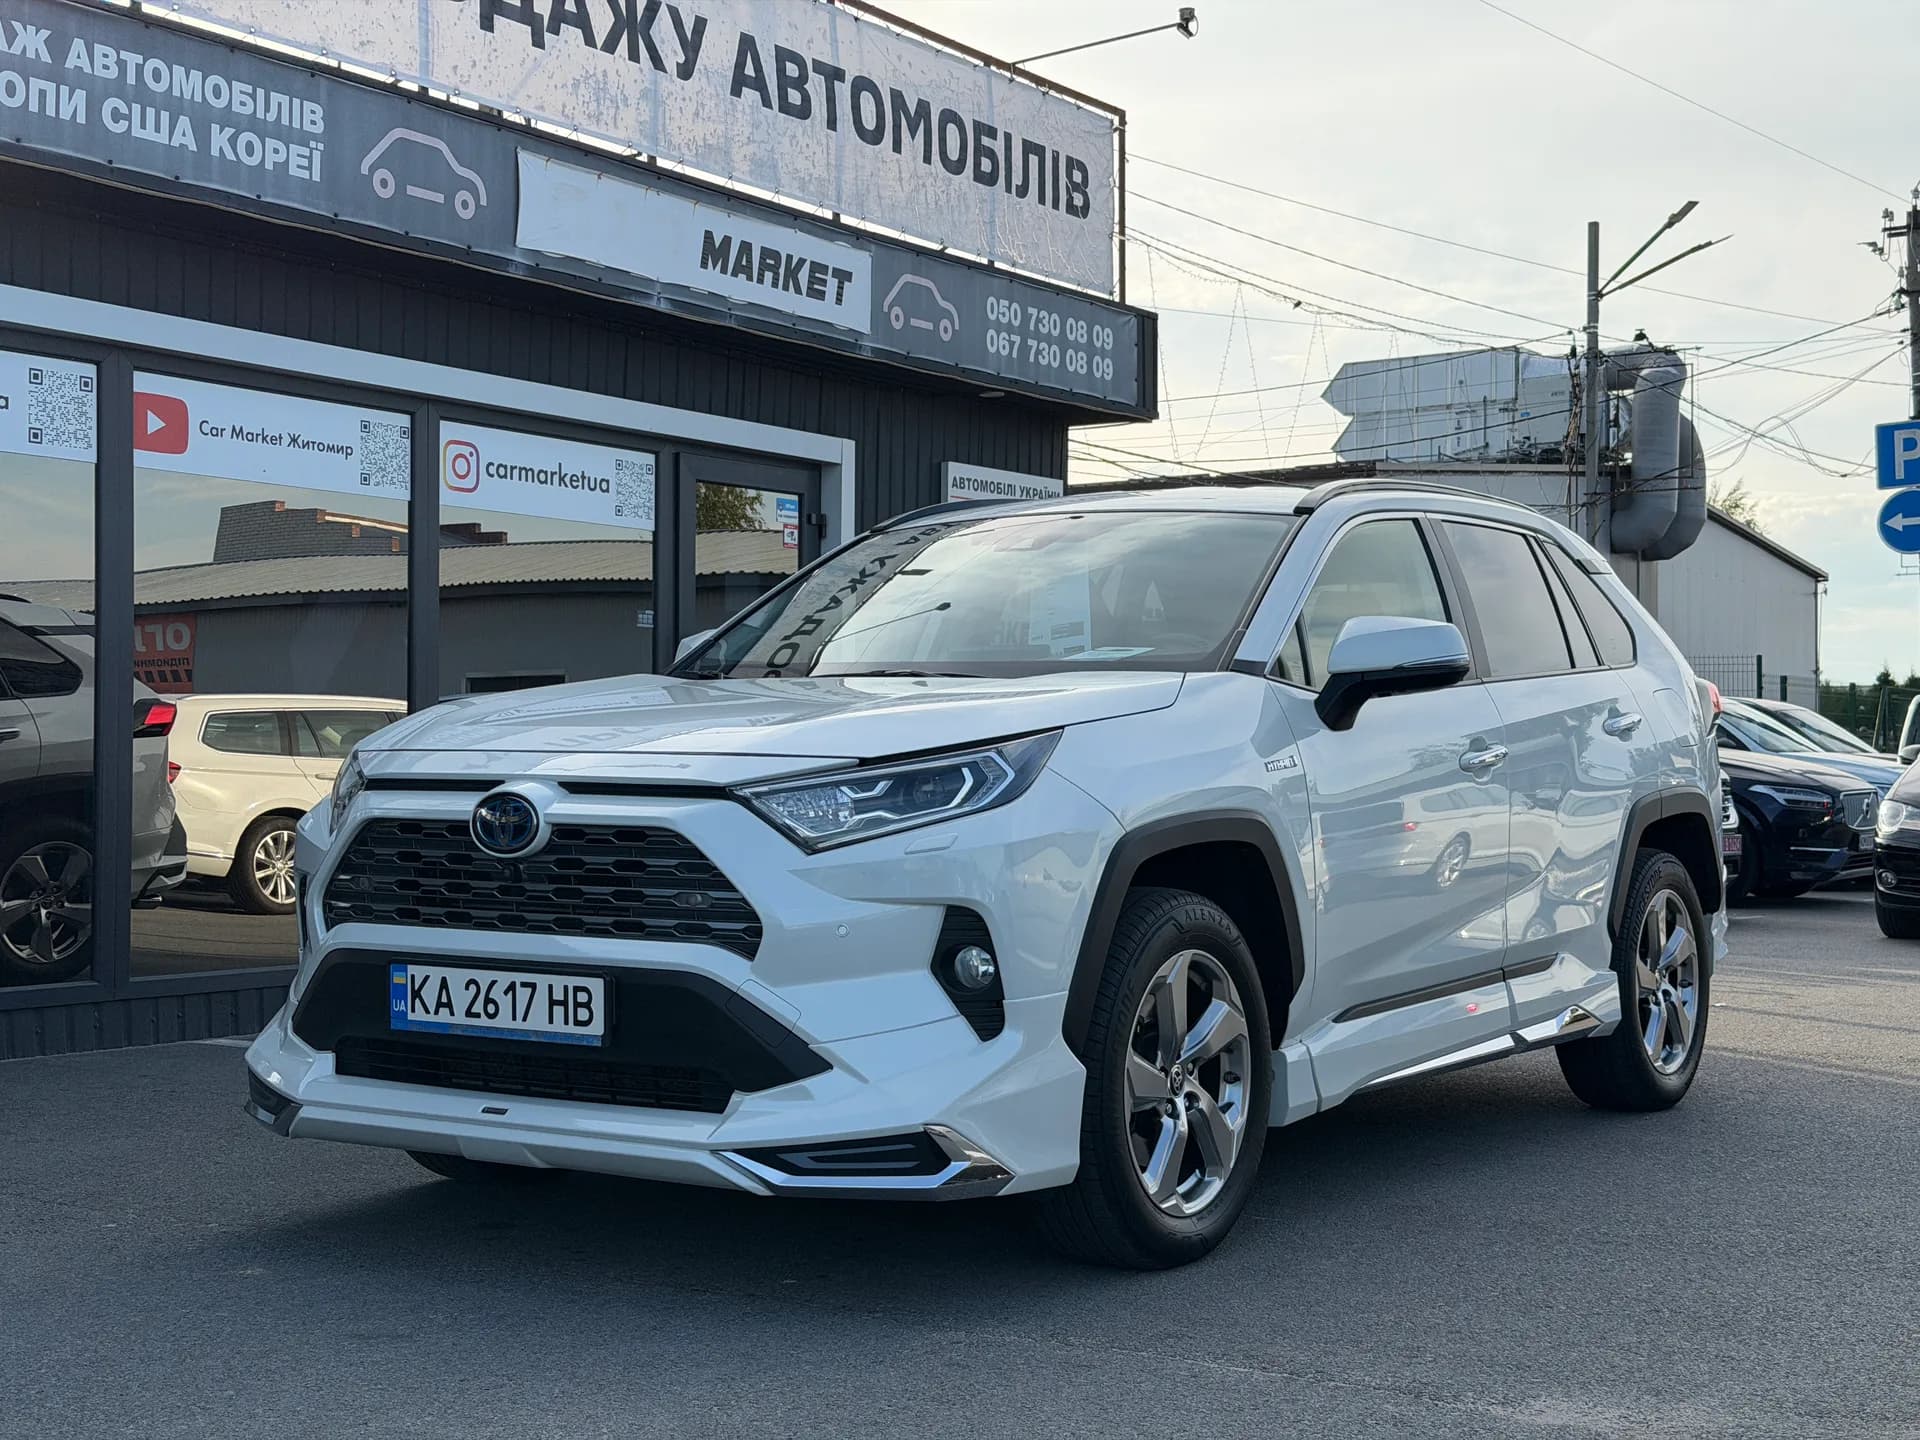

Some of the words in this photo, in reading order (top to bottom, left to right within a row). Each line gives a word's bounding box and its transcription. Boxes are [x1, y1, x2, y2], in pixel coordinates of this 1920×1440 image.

[64, 37, 325, 134] АВТОМОБІЛІВ
[451, 0, 708, 81] ДАЖУ
[730, 31, 1091, 220] АВТОМОБІЛІВ
[101, 97, 197, 152] США
[210, 122, 325, 182] КОРЕЇ
[699, 229, 854, 306] MARKET
[986, 296, 1021, 327] 050
[1027, 306, 1060, 337] 730
[1066, 317, 1087, 343] 08
[1093, 325, 1113, 350] 09
[986, 329, 1021, 358] 067
[1027, 338, 1060, 368] 730
[1066, 349, 1087, 375] 08
[1093, 355, 1113, 380] 09
[199, 420, 226, 438] Car
[230, 424, 284, 447] Market
[287, 432, 354, 460] Житомир
[1894, 429, 1920, 480] P
[485, 462, 610, 494] carmarketua
[951, 475, 1017, 497] АВТОМОБІЛІ
[392, 999, 407, 1012] UA
[409, 973, 456, 1017] KA
[464, 978, 537, 1022] 2617
[547, 983, 594, 1028] HB
